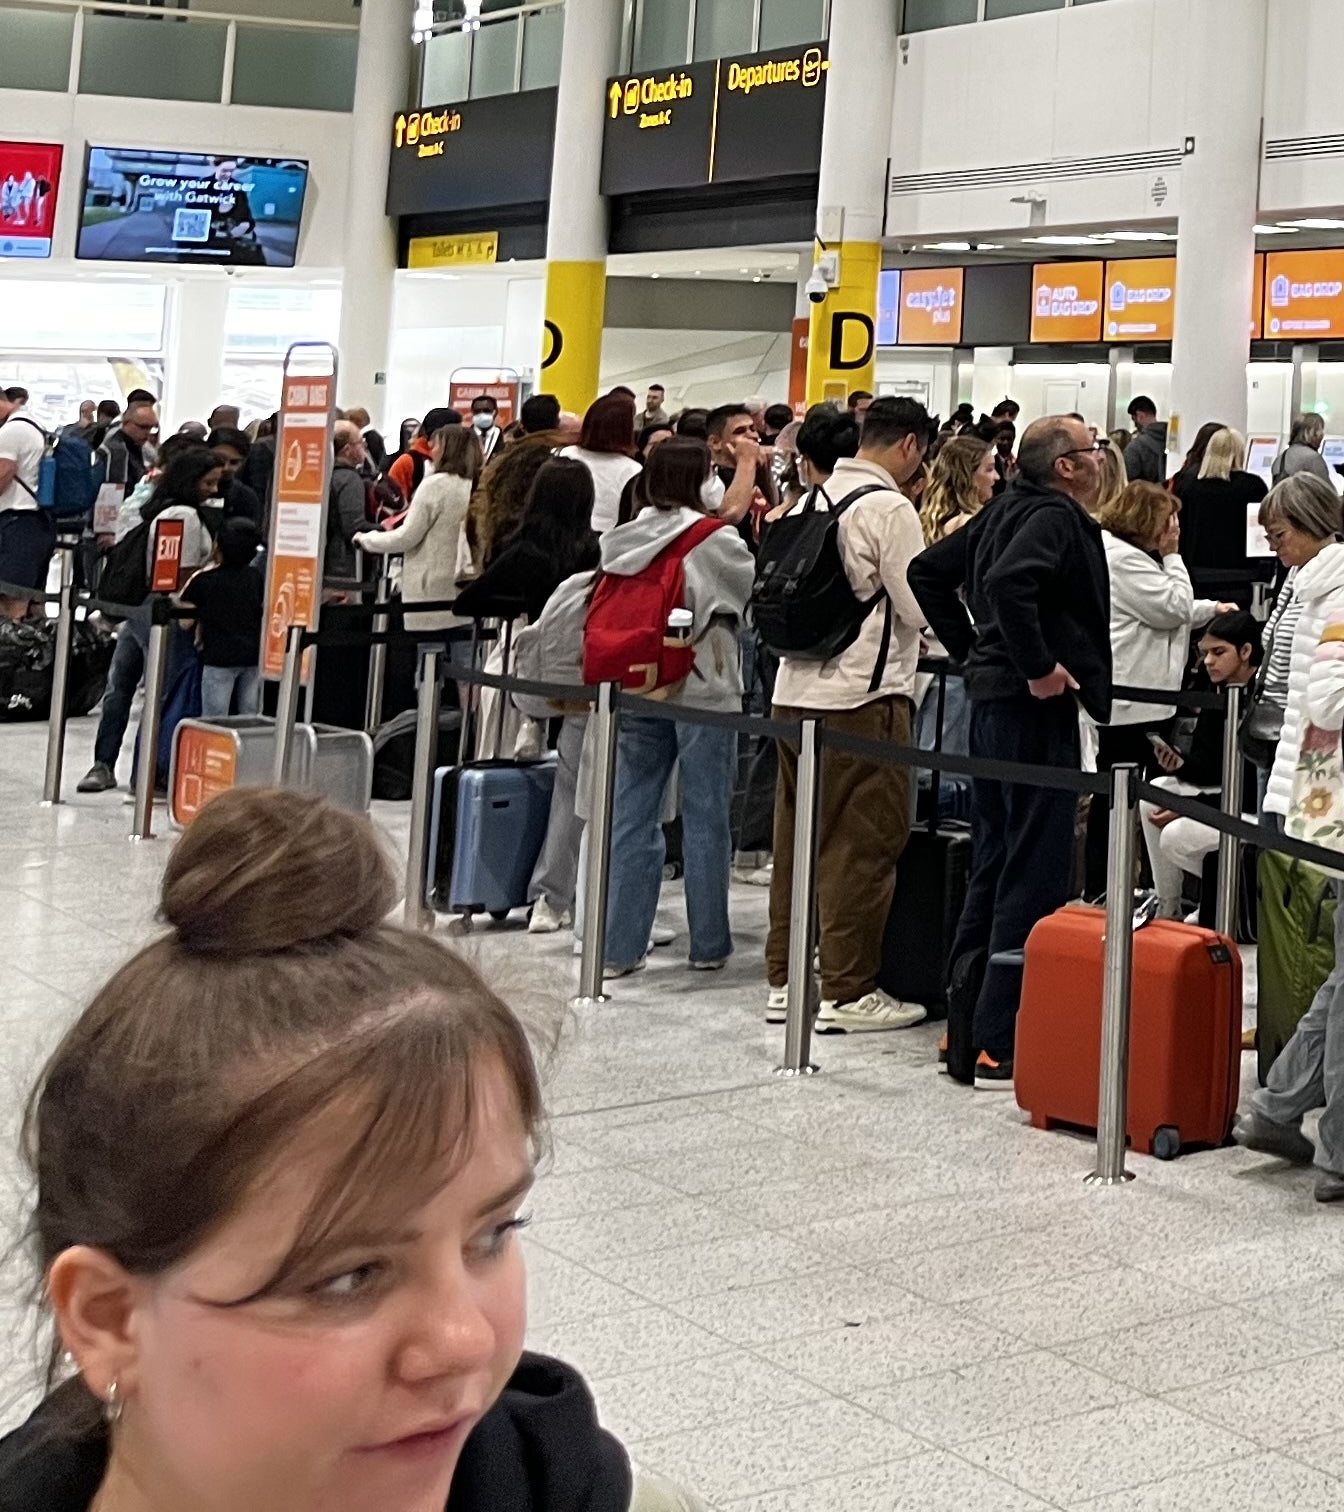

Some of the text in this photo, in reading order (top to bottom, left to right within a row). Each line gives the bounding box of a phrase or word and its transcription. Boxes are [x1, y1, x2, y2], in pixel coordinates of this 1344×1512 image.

[728, 58, 799, 94] Departures
[642, 73, 692, 104] Check-in
[421, 109, 461, 137] Check-in
[139, 174, 255, 192] Grow your career
[154, 190, 236, 205] with Gatwick
[1052, 286, 1077, 300] AUTO
[1291, 282, 1343, 298] BAG DROP
[829, 311, 875, 370] D
[159, 536, 180, 560] EXIT
